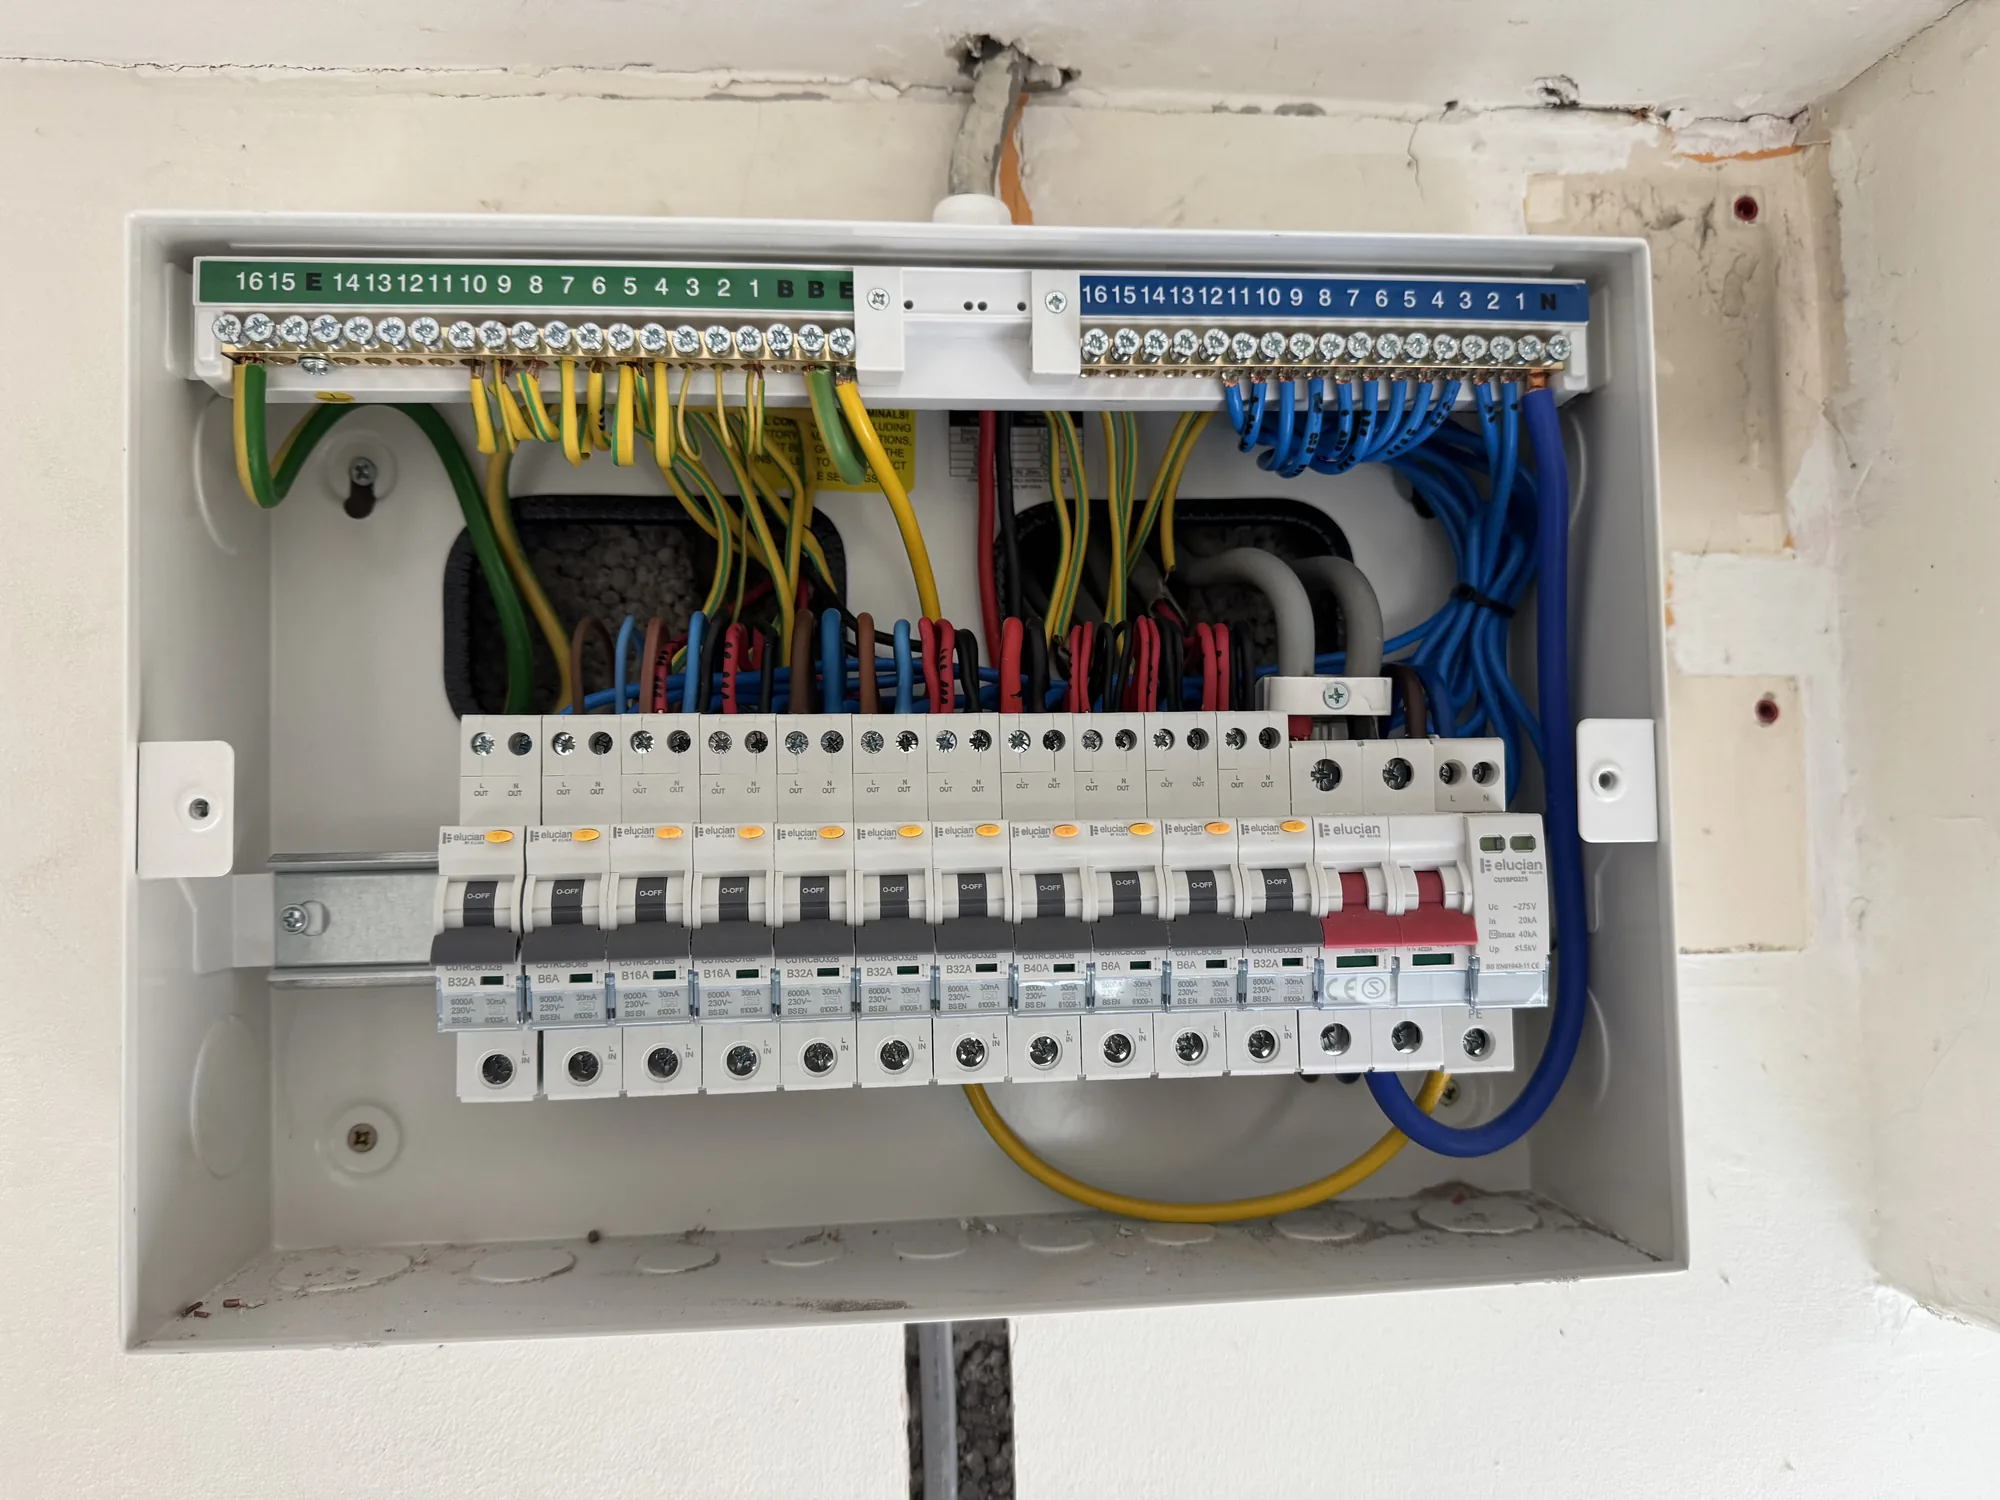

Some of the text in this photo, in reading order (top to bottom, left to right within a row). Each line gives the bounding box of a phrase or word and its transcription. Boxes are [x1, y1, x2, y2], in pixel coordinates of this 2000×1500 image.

[236, 272, 854, 299] 16 15 E 14 13 12 11 10 9 8 7 6 5 4 3 2 1 B B E
[1082, 286, 1557, 310] 16 15 14 13 12 11 10 9 8 7 6 5 4 3 2 1 N
[1451, 794, 1456, 802] L
[1483, 794, 1489, 802] N
[624, 826, 654, 836] elucian
[705, 826, 736, 835] elucian
[945, 826, 974, 835] elucian
[1021, 826, 1051, 836] elucian
[1100, 825, 1128, 834] elucian
[1174, 823, 1203, 833] elucian
[1251, 823, 1280, 832] elucian
[1333, 823, 1381, 835] elucian
[454, 832, 485, 841] elucian
[541, 830, 572, 839] elucian
[787, 828, 817, 837] elucian
[867, 828, 897, 837] elucian
[1494, 858, 1543, 871] elucian
[1488, 903, 1499, 911] Uc
[1518, 916, 1537, 924] 20kA
[1489, 946, 1500, 954] Up
[1101, 961, 1120, 971] B6A
[1177, 960, 1196, 970] B6A
[1253, 959, 1279, 968] B32A
[867, 967, 893, 976] B32A
[946, 964, 972, 974] B32A
[1024, 964, 1049, 973] B40A
[622, 971, 649, 980] B16A
[703, 969, 731, 978] B16A
[787, 969, 813, 978] B32A
[448, 978, 476, 987] B32A
[538, 974, 560, 983] B6A
[1133, 980, 1152, 988] 30mA
[659, 990, 679, 998] 30mA
[1469, 1009, 1482, 1019] PE
